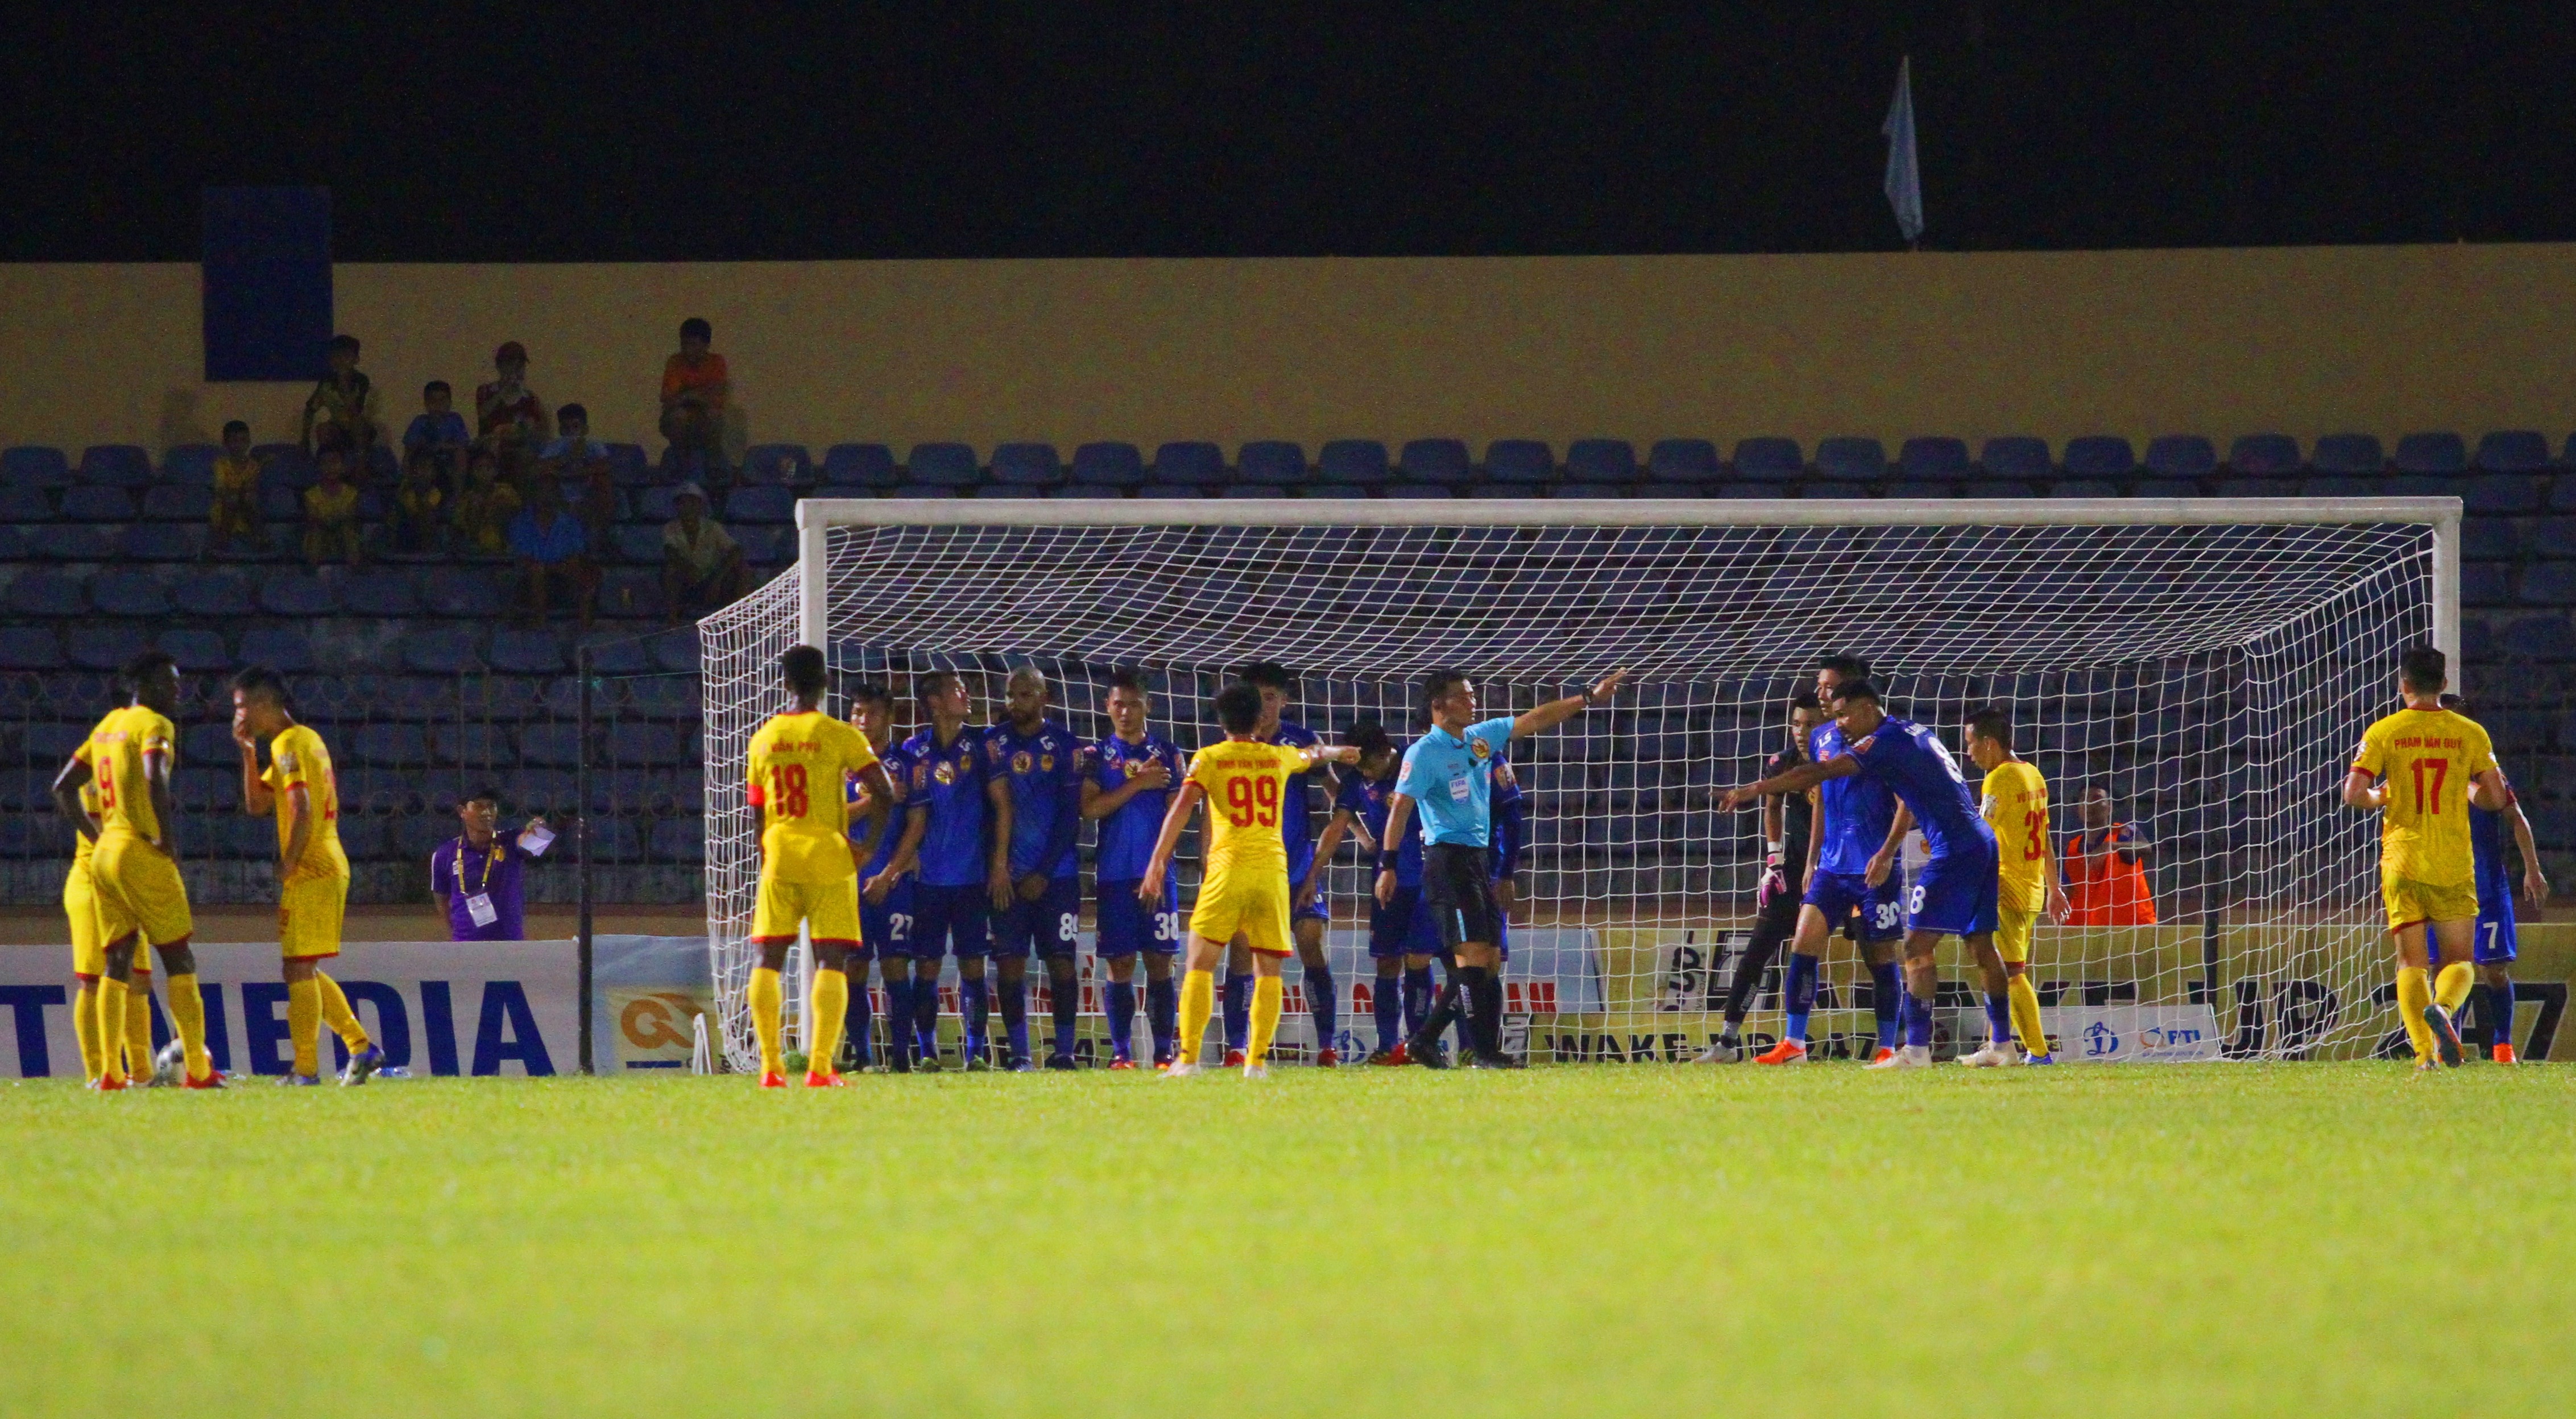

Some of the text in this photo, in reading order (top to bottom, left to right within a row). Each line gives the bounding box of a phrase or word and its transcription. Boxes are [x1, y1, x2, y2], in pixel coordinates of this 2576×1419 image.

[1928, 737, 1963, 784] 8
[98, 756, 115, 808] 9
[772, 764, 808, 819] 18
[2411, 758, 2448, 814] 17
[1227, 775, 1277, 828] 99
[1910, 885, 1926, 914] 8
[890, 913, 913, 941] 27
[1154, 913, 1178, 941] 38
[1876, 901, 1900, 929] 30
[2483, 921, 2499, 949] 7
[2167, 1029, 2201, 1045] PTI
